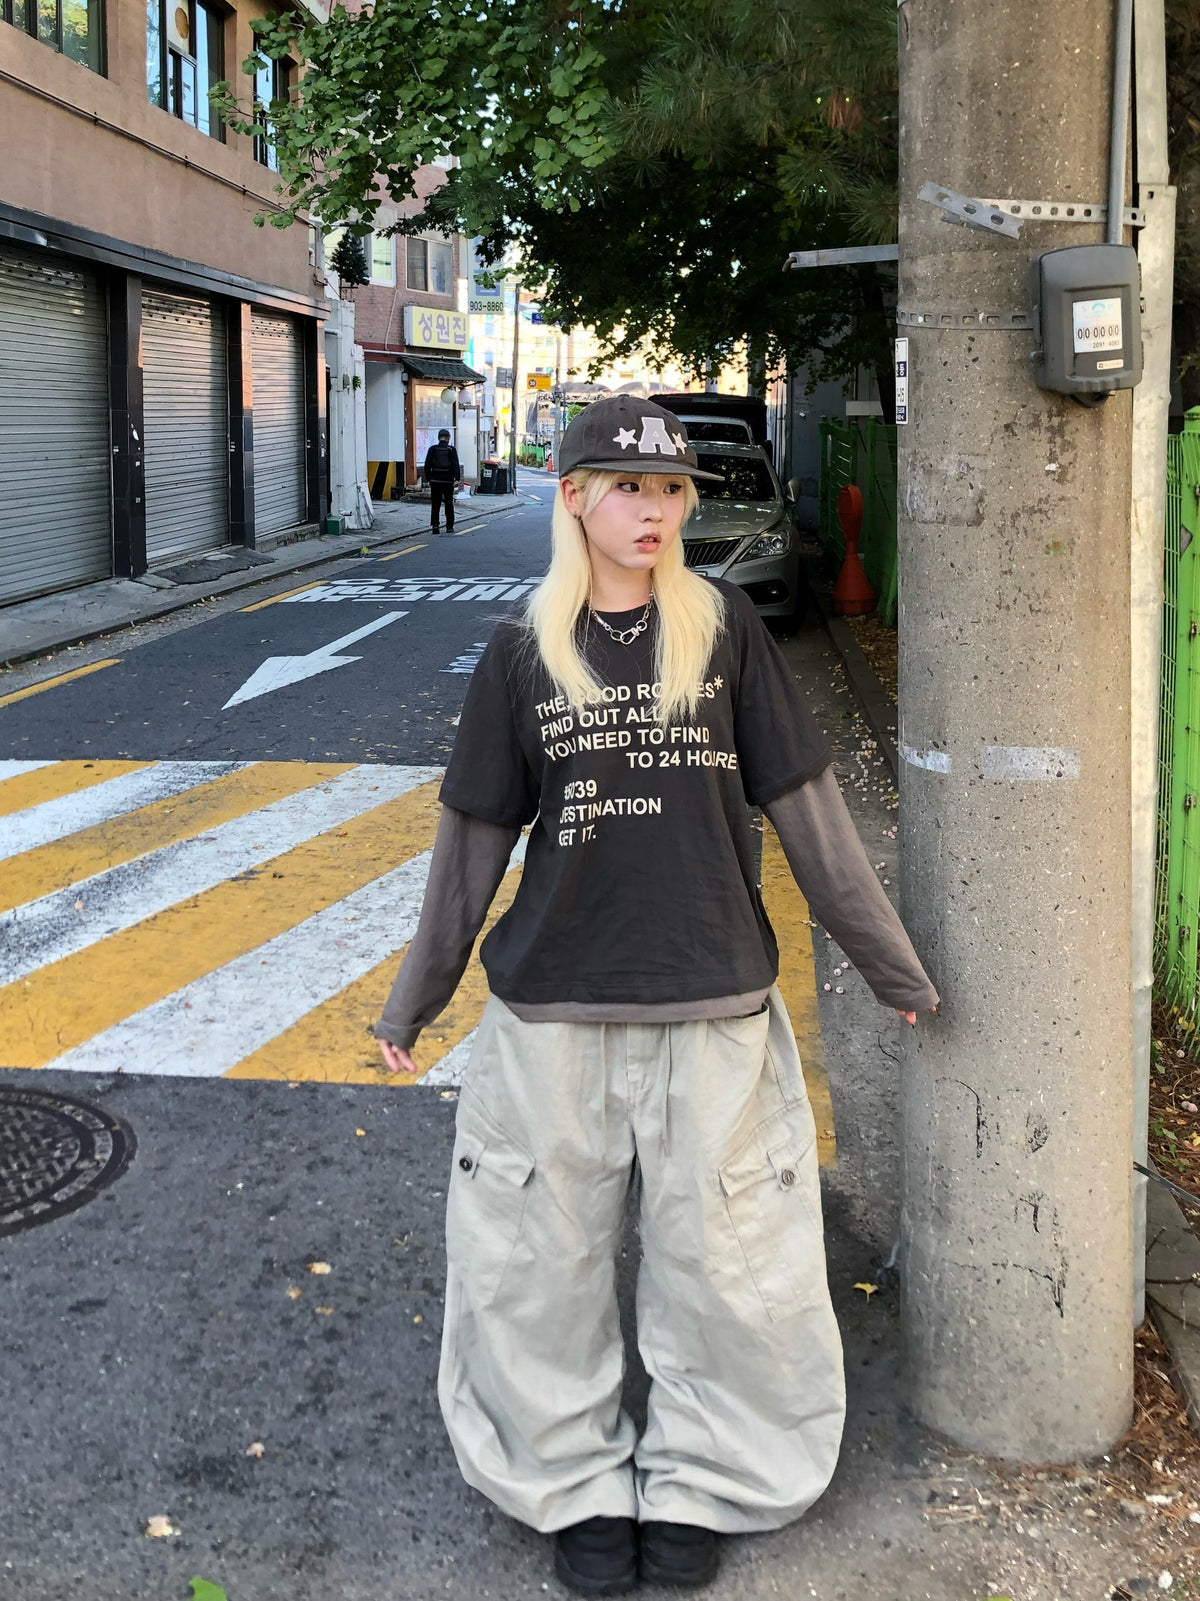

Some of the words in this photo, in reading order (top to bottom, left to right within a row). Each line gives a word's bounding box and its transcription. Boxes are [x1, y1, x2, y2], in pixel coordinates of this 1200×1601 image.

[469, 301, 503, 312] 903-8860
[418, 312, 466, 345] 성원집
[638, 416, 677, 456] A
[637, 675, 724, 699] ROES
[540, 715, 574, 742] FIND
[579, 708, 621, 728] OUT
[625, 707, 664, 724] ALL
[544, 737, 577, 762] YOU
[578, 730, 631, 752] NEED
[637, 728, 664, 745] TO
[670, 726, 710, 744] FIND
[626, 751, 654, 769] TO
[659, 750, 681, 768] 24
[558, 828, 577, 847] GET
[581, 823, 597, 844] IT.
